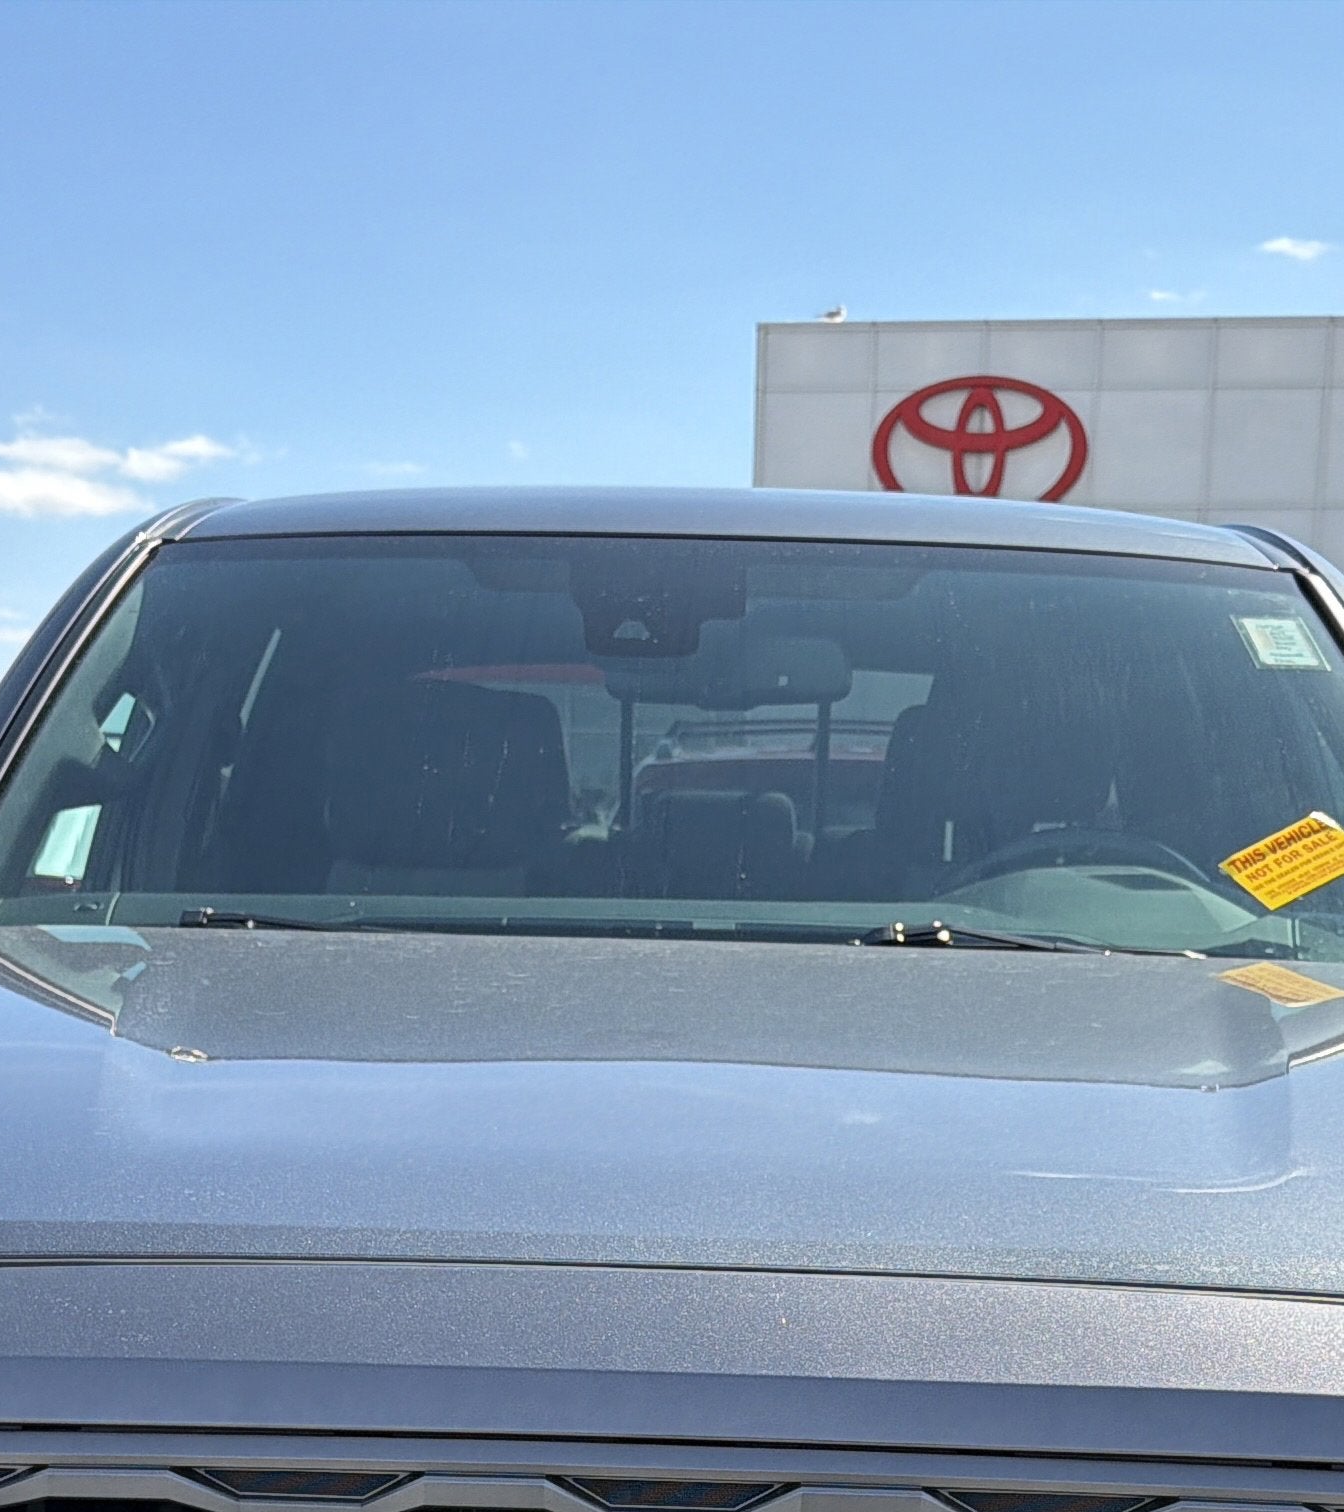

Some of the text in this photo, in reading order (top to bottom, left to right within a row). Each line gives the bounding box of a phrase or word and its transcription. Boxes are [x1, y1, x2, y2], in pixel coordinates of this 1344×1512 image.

[1227, 848, 1267, 874] THIS
[1264, 819, 1329, 855] VEHICLE
[1245, 867, 1275, 883] NOT
[1273, 850, 1304, 868] FOR
[1306, 831, 1338, 852] SALE
